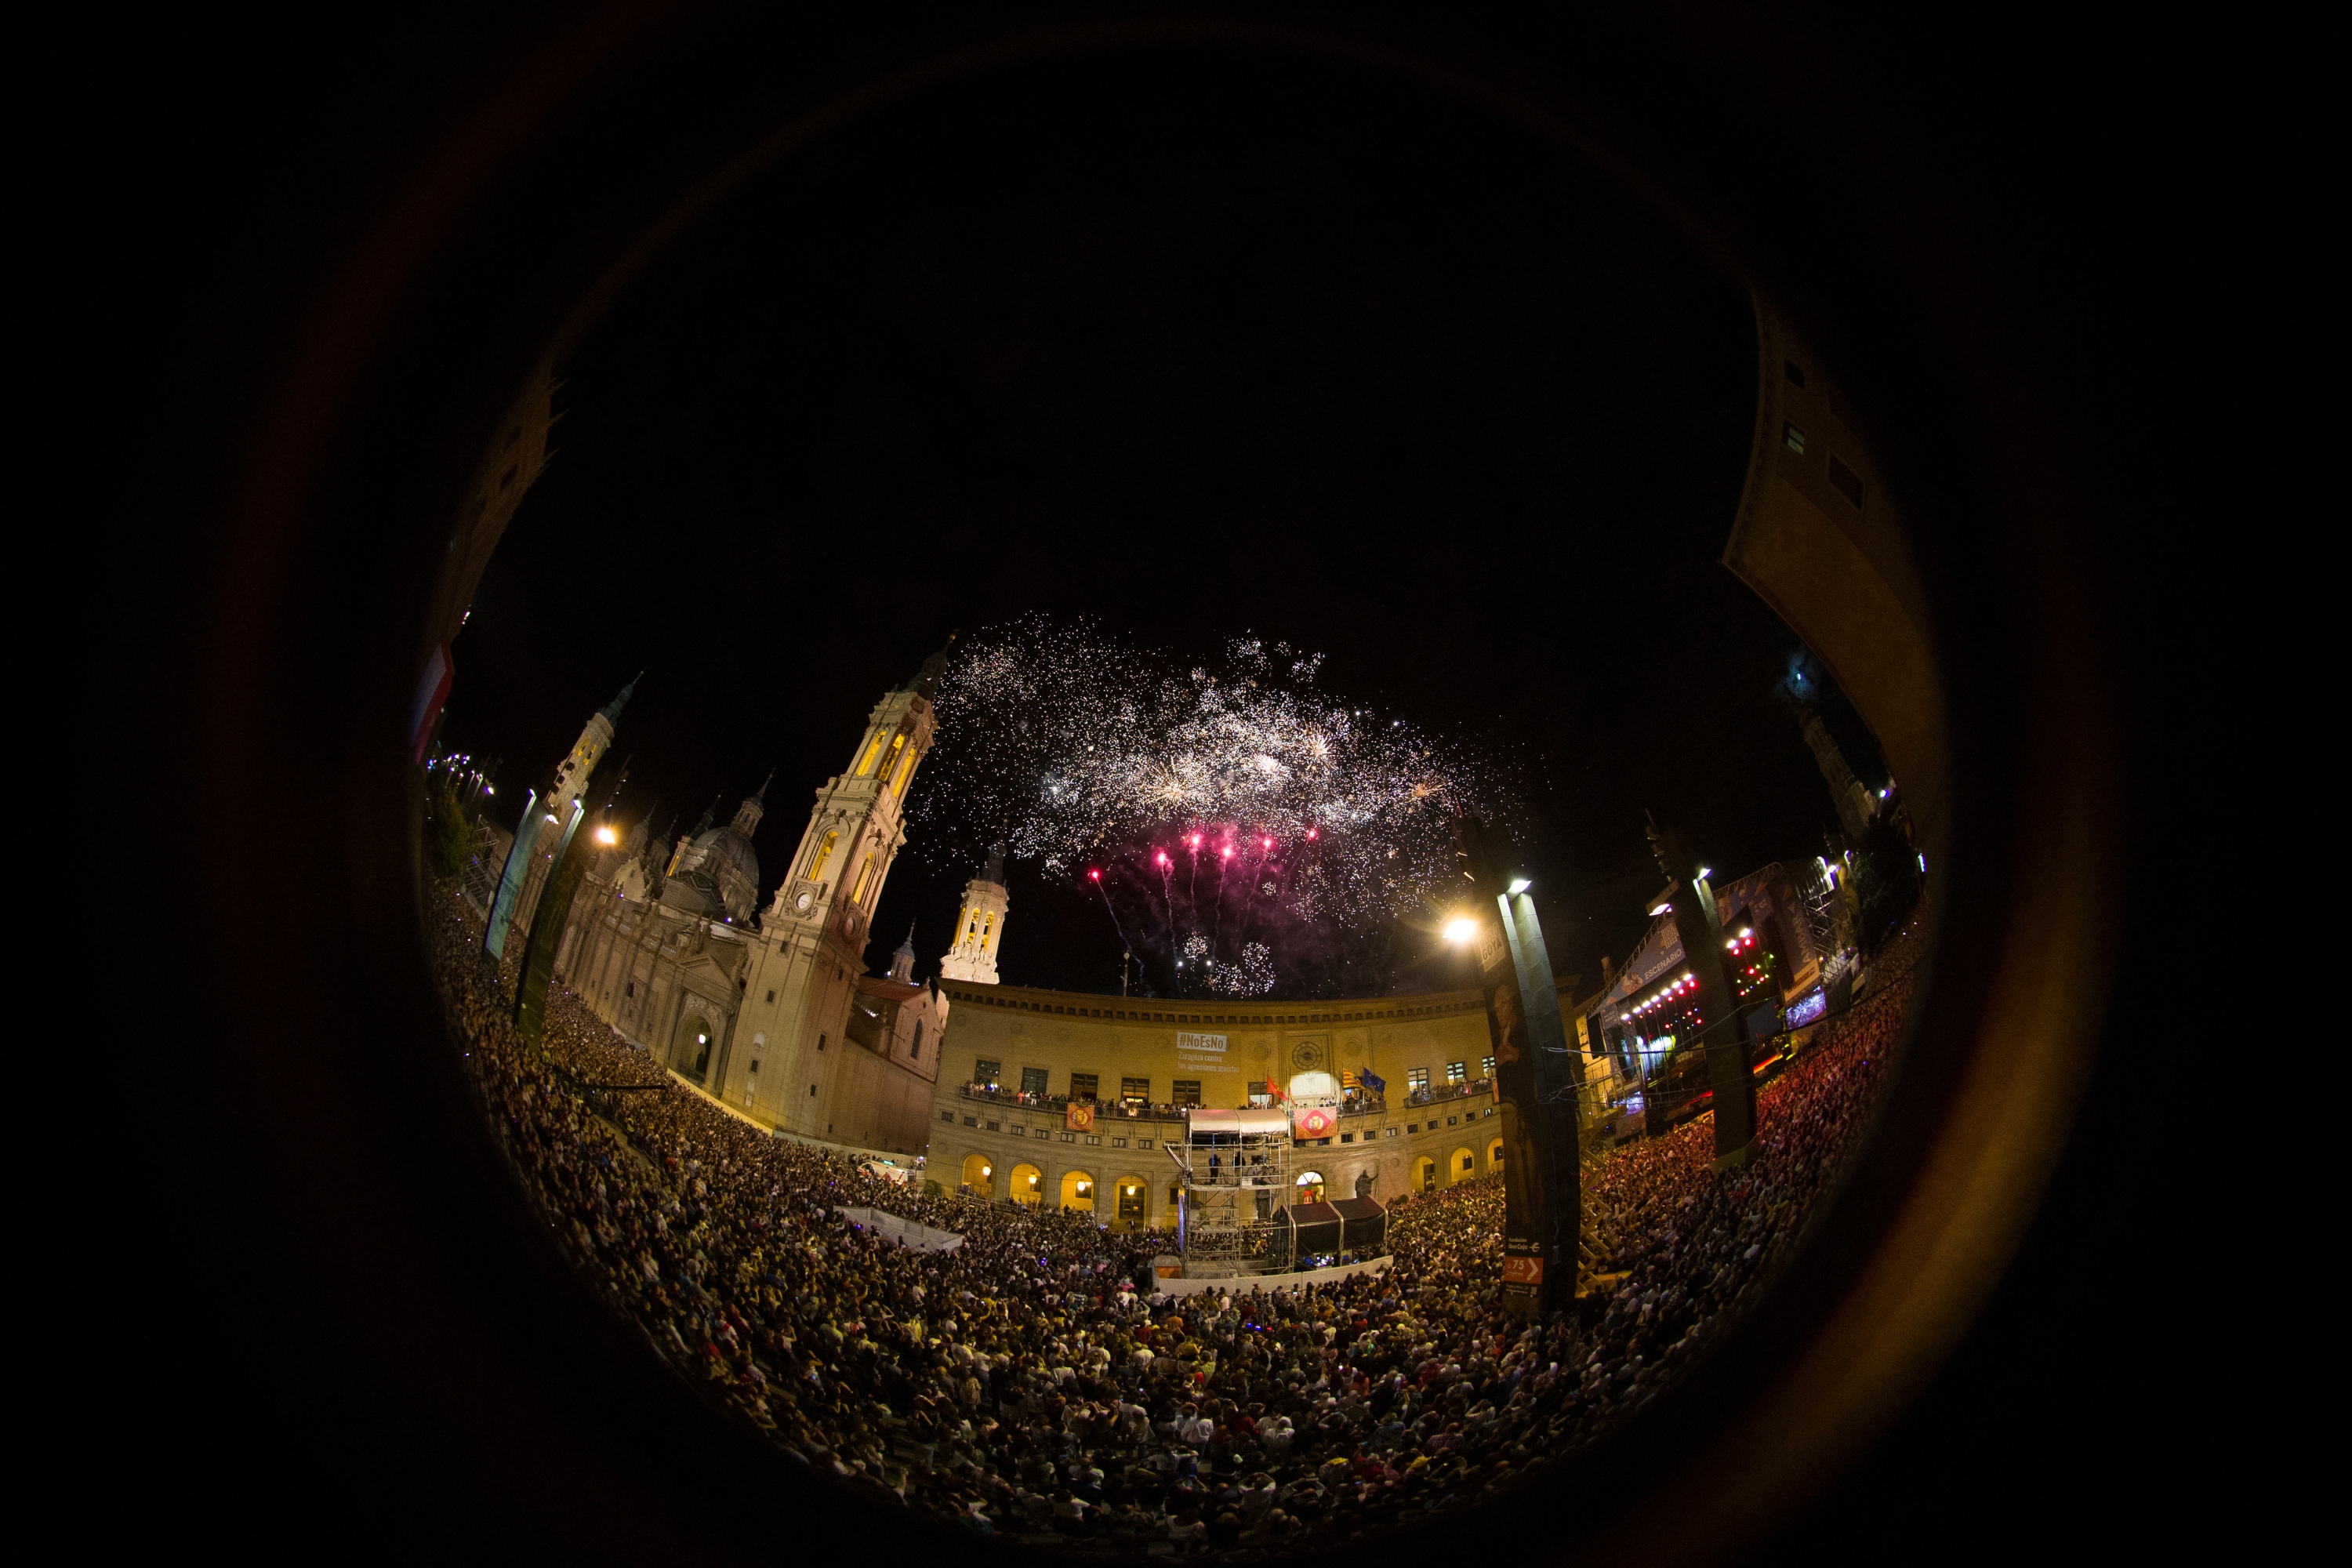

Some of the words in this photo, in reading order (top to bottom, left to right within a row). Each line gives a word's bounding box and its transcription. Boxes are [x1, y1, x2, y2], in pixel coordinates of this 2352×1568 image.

[1482, 936, 1502, 960] GOYA
[1644, 948, 1682, 980] ESCENARIO
[1179, 1033, 1224, 1049] #NoEsNo
[1178, 1051, 1203, 1062] Zaragoza
[1187, 1063, 1217, 1072] agresiones
[1513, 1259, 1524, 1270] 75
